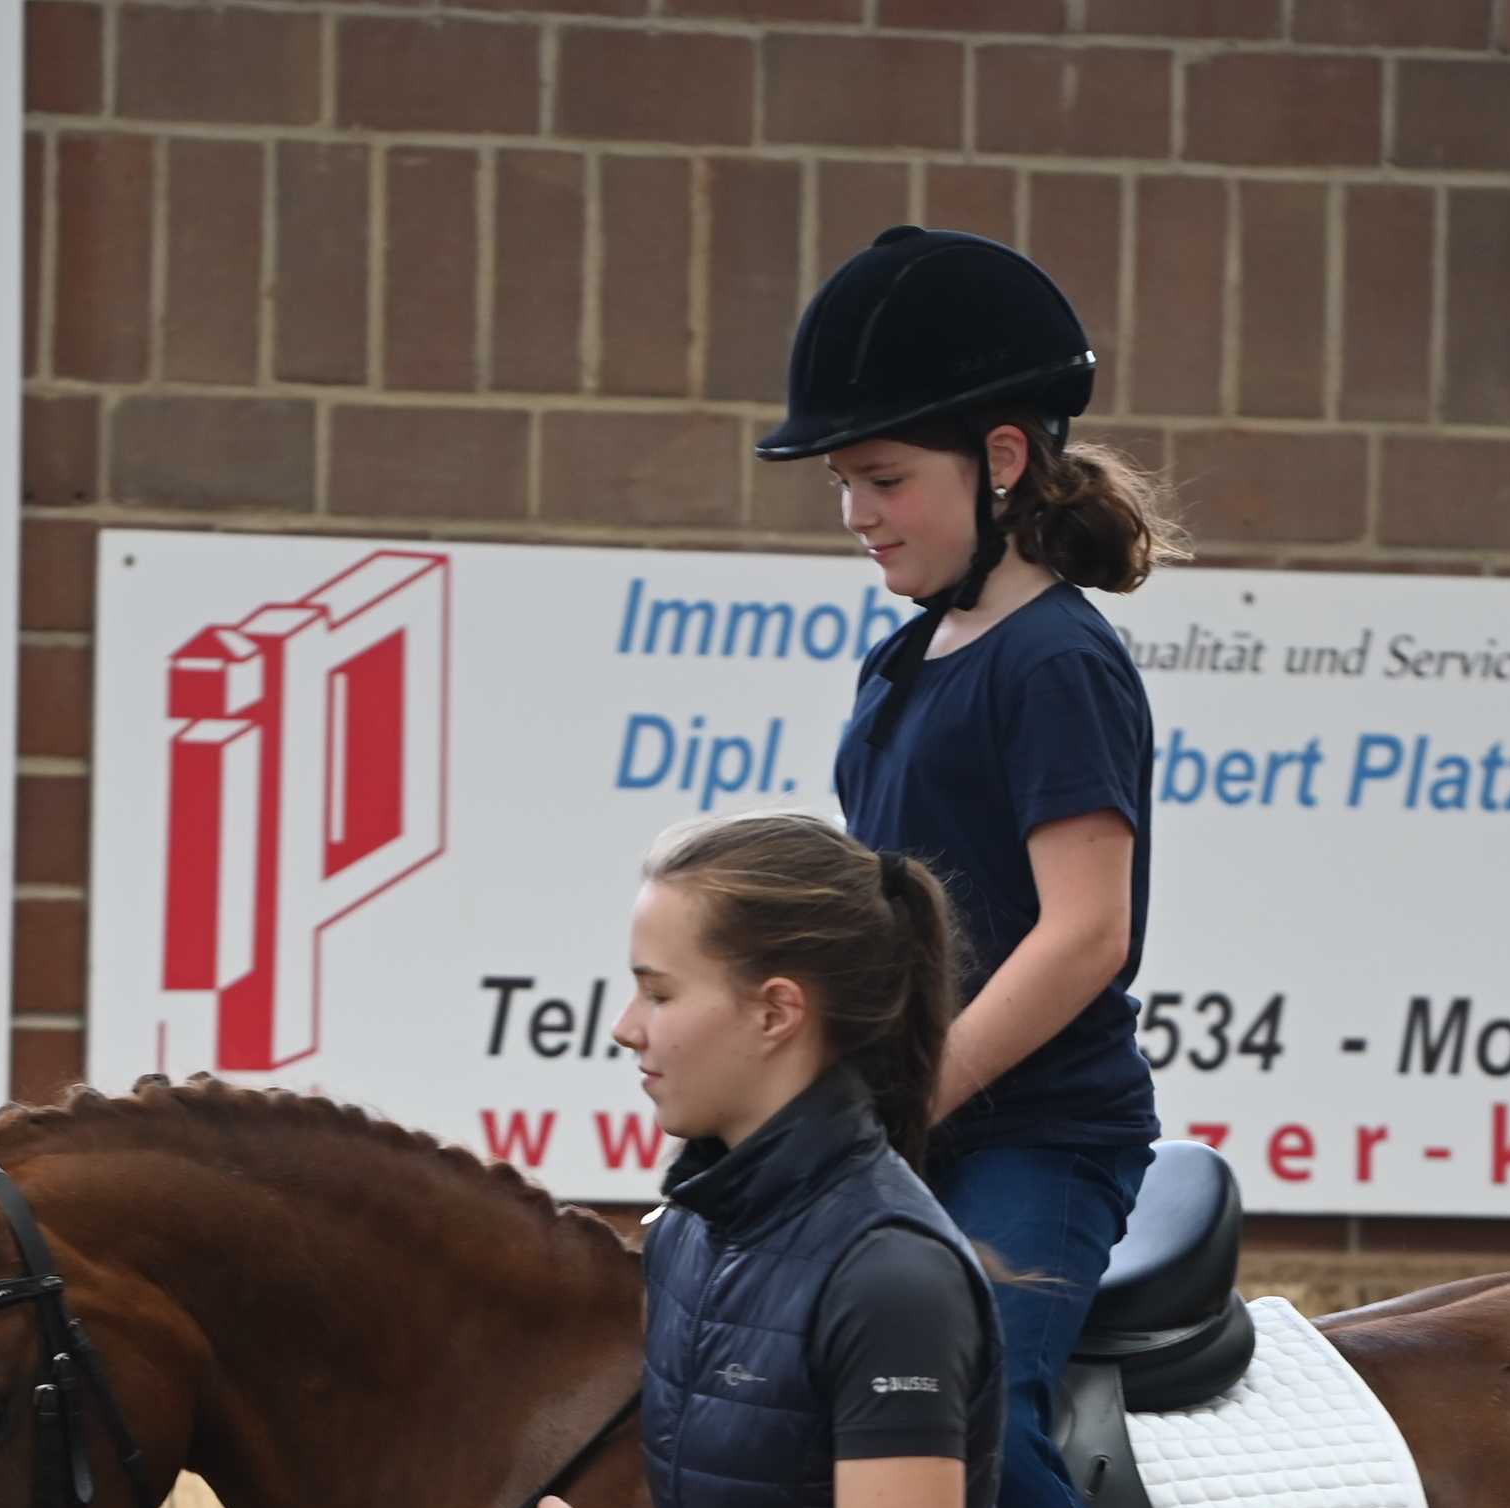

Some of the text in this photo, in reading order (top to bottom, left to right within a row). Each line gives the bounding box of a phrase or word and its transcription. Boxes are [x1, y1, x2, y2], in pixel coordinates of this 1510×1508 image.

[1284, 628, 1373, 677] und
[615, 713, 796, 812] Dipl.
[1153, 728, 1324, 809] bert
[480, 975, 621, 1060] Tel.
